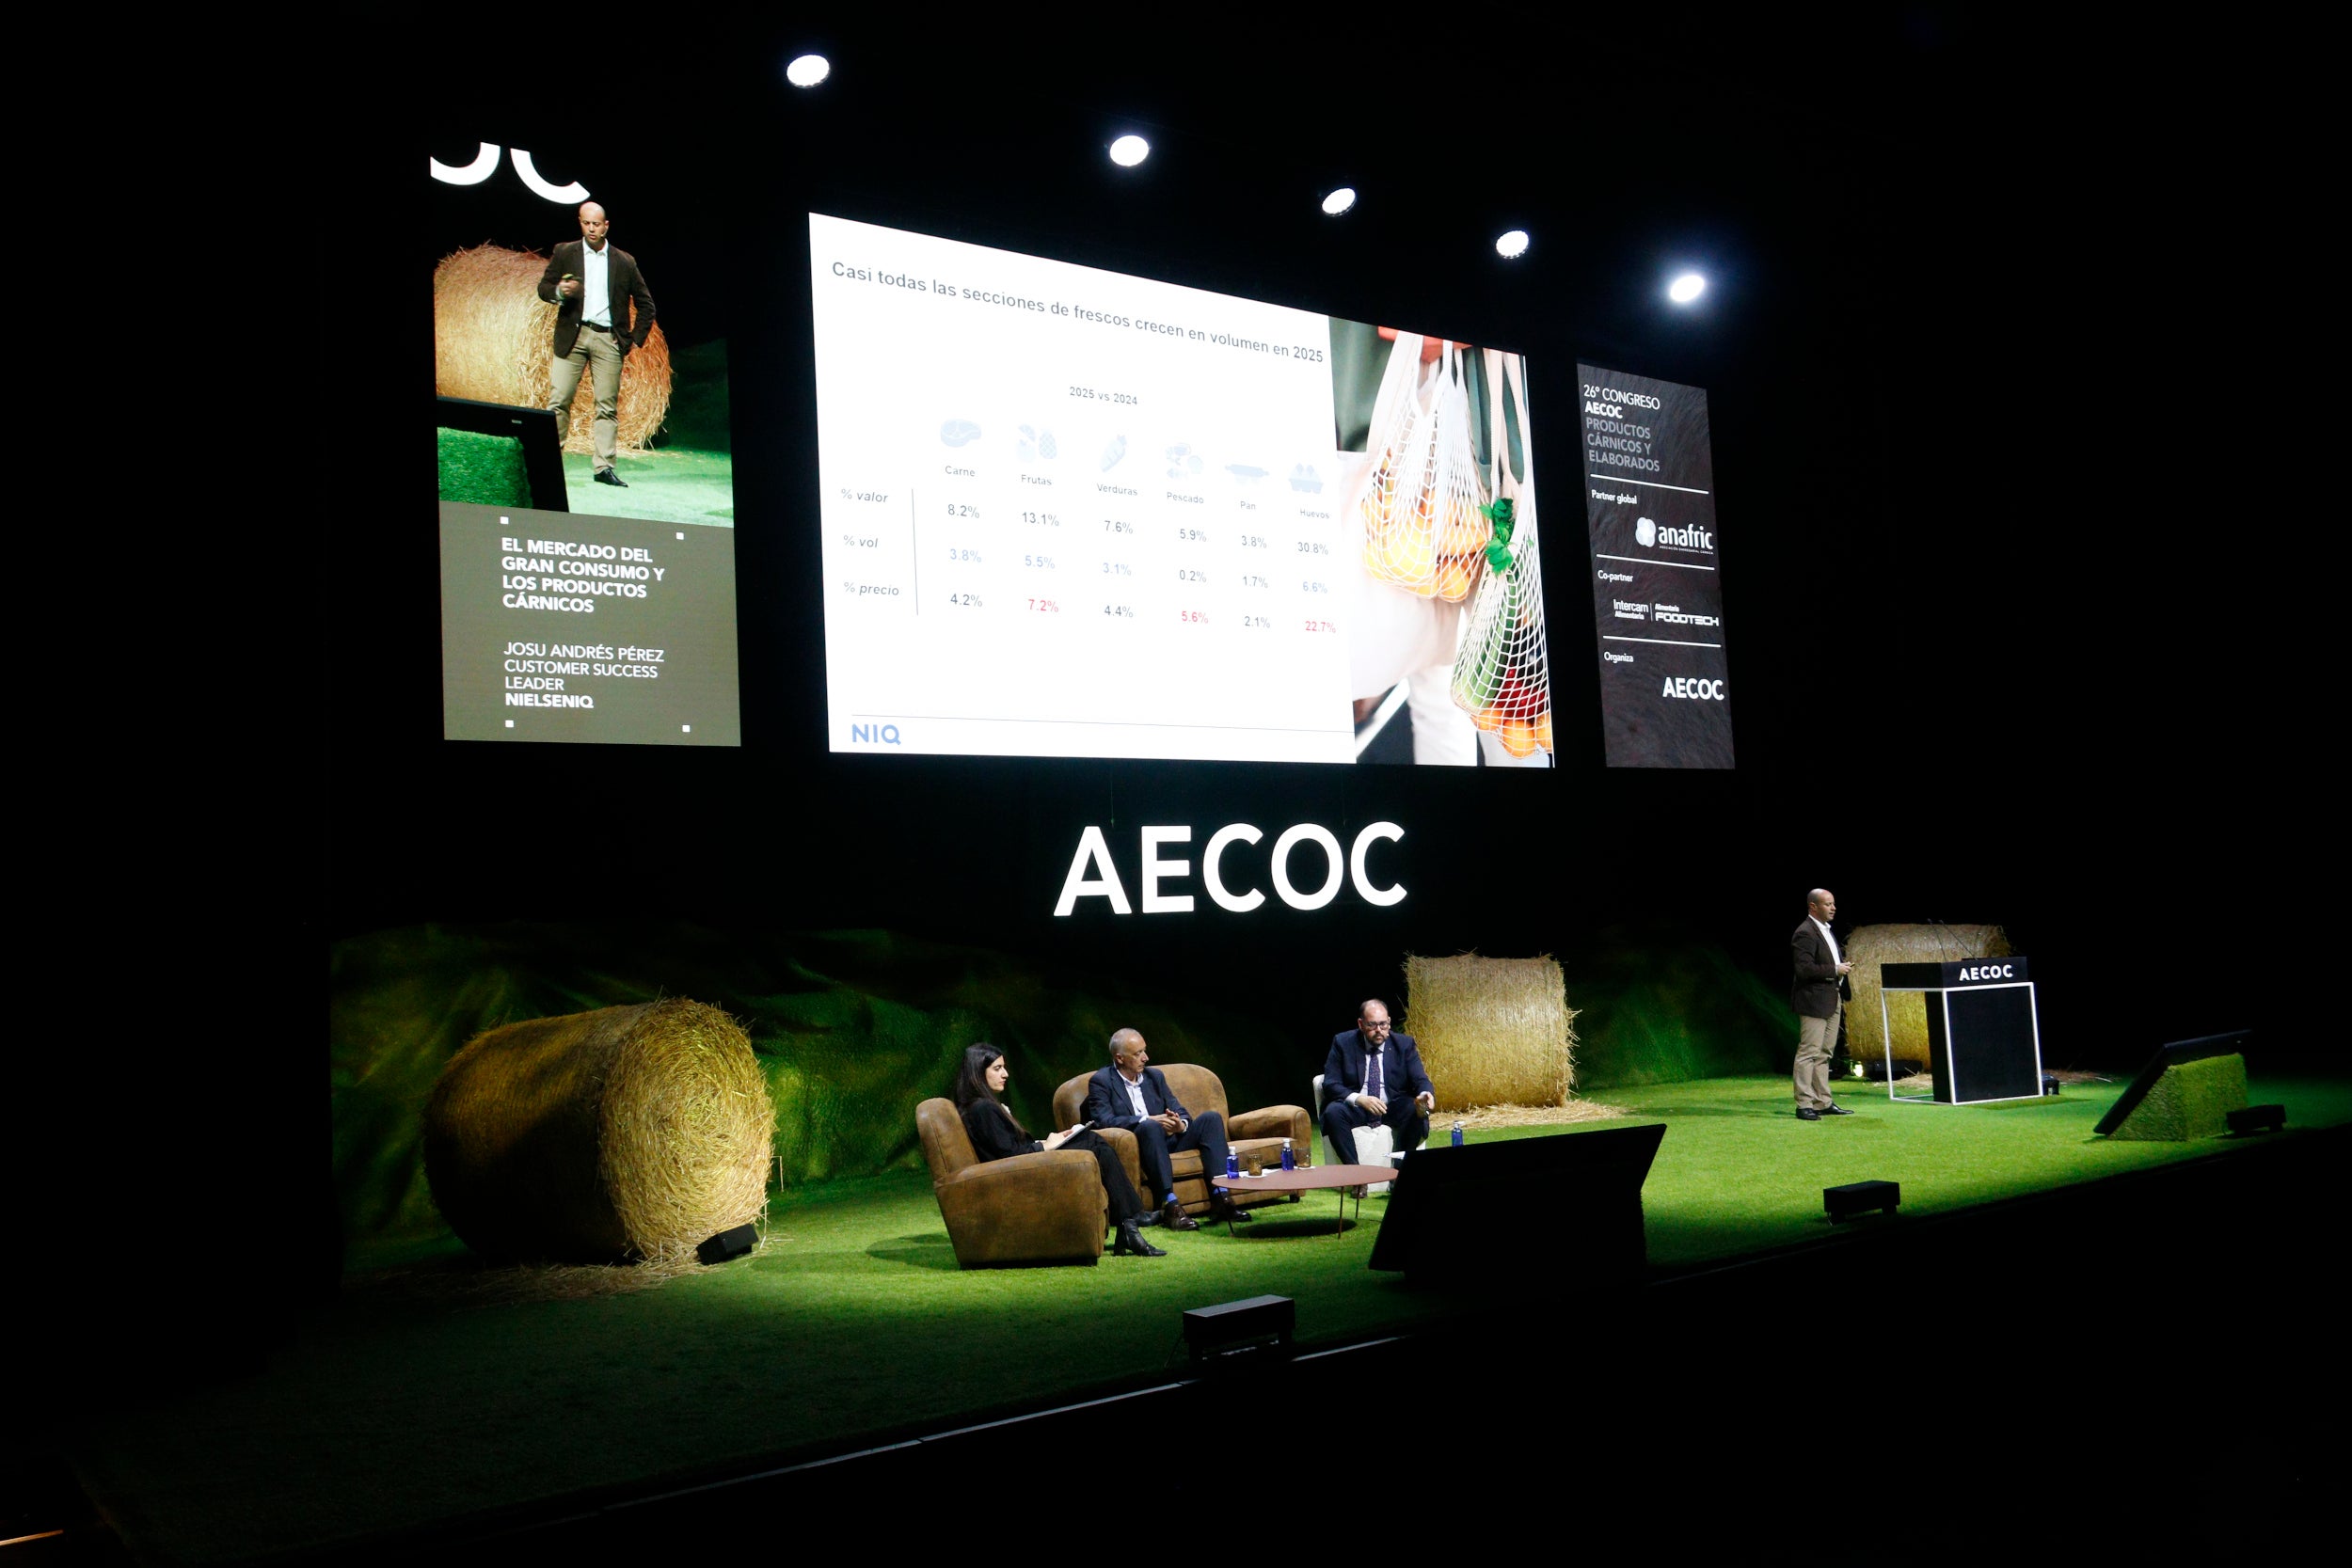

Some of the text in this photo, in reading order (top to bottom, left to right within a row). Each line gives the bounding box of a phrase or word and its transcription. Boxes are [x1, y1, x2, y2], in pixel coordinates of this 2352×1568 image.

[832, 261, 1324, 362] Casi todas las secciones de frescos crecen en volumen en 2025
[1070, 387, 1137, 405] 2025 vs 2024
[1602, 388, 1661, 410] CONGRESO
[1585, 401, 1623, 419] AECOC
[1586, 417, 1651, 439] PRODUCTOS
[1587, 433, 1651, 455] CÁRNICOS Y
[1589, 450, 1661, 471] ELABORADOS
[946, 466, 1329, 519] Carne Frutas Verduras Pescado Pan Huevos
[1592, 489, 1637, 504] Partner global
[841, 488, 1328, 555] % valor 8.2% 13.1% 7.6% 5.9% 3.8% 30.8%
[1659, 523, 1713, 549] anafric
[501, 537, 653, 562] EL MERCADO DEL
[501, 556, 665, 581] GRAN CONSUMO Y
[843, 535, 1327, 594] % vol 3.8% 5.5% 3.1% 0.2% 1.7% 6.6%
[502, 575, 647, 598] LOS PRODUCTOS
[1597, 570, 1633, 582] Co-partner
[502, 592, 595, 613] CÁRNICOS
[844, 581, 1336, 634] % precio 4.2% 7.2% 4.4% 5.6% 2.1% 22.7%
[1613, 599, 1648, 612] Intercam
[1655, 612, 1719, 626] FOODTECH
[503, 641, 664, 662] JOSU ANDRÉS PÉREZ
[1604, 652, 1634, 663] Organiza
[504, 659, 659, 678] CUSTOMER SUCCESS
[505, 676, 564, 690] LEADER
[1662, 677, 1724, 701] AECOC
[505, 693, 594, 708] NIELSENIQ
[852, 723, 901, 745] NIQ
[1053, 821, 1407, 916] AECOC
[1959, 964, 2013, 981] AECOC
